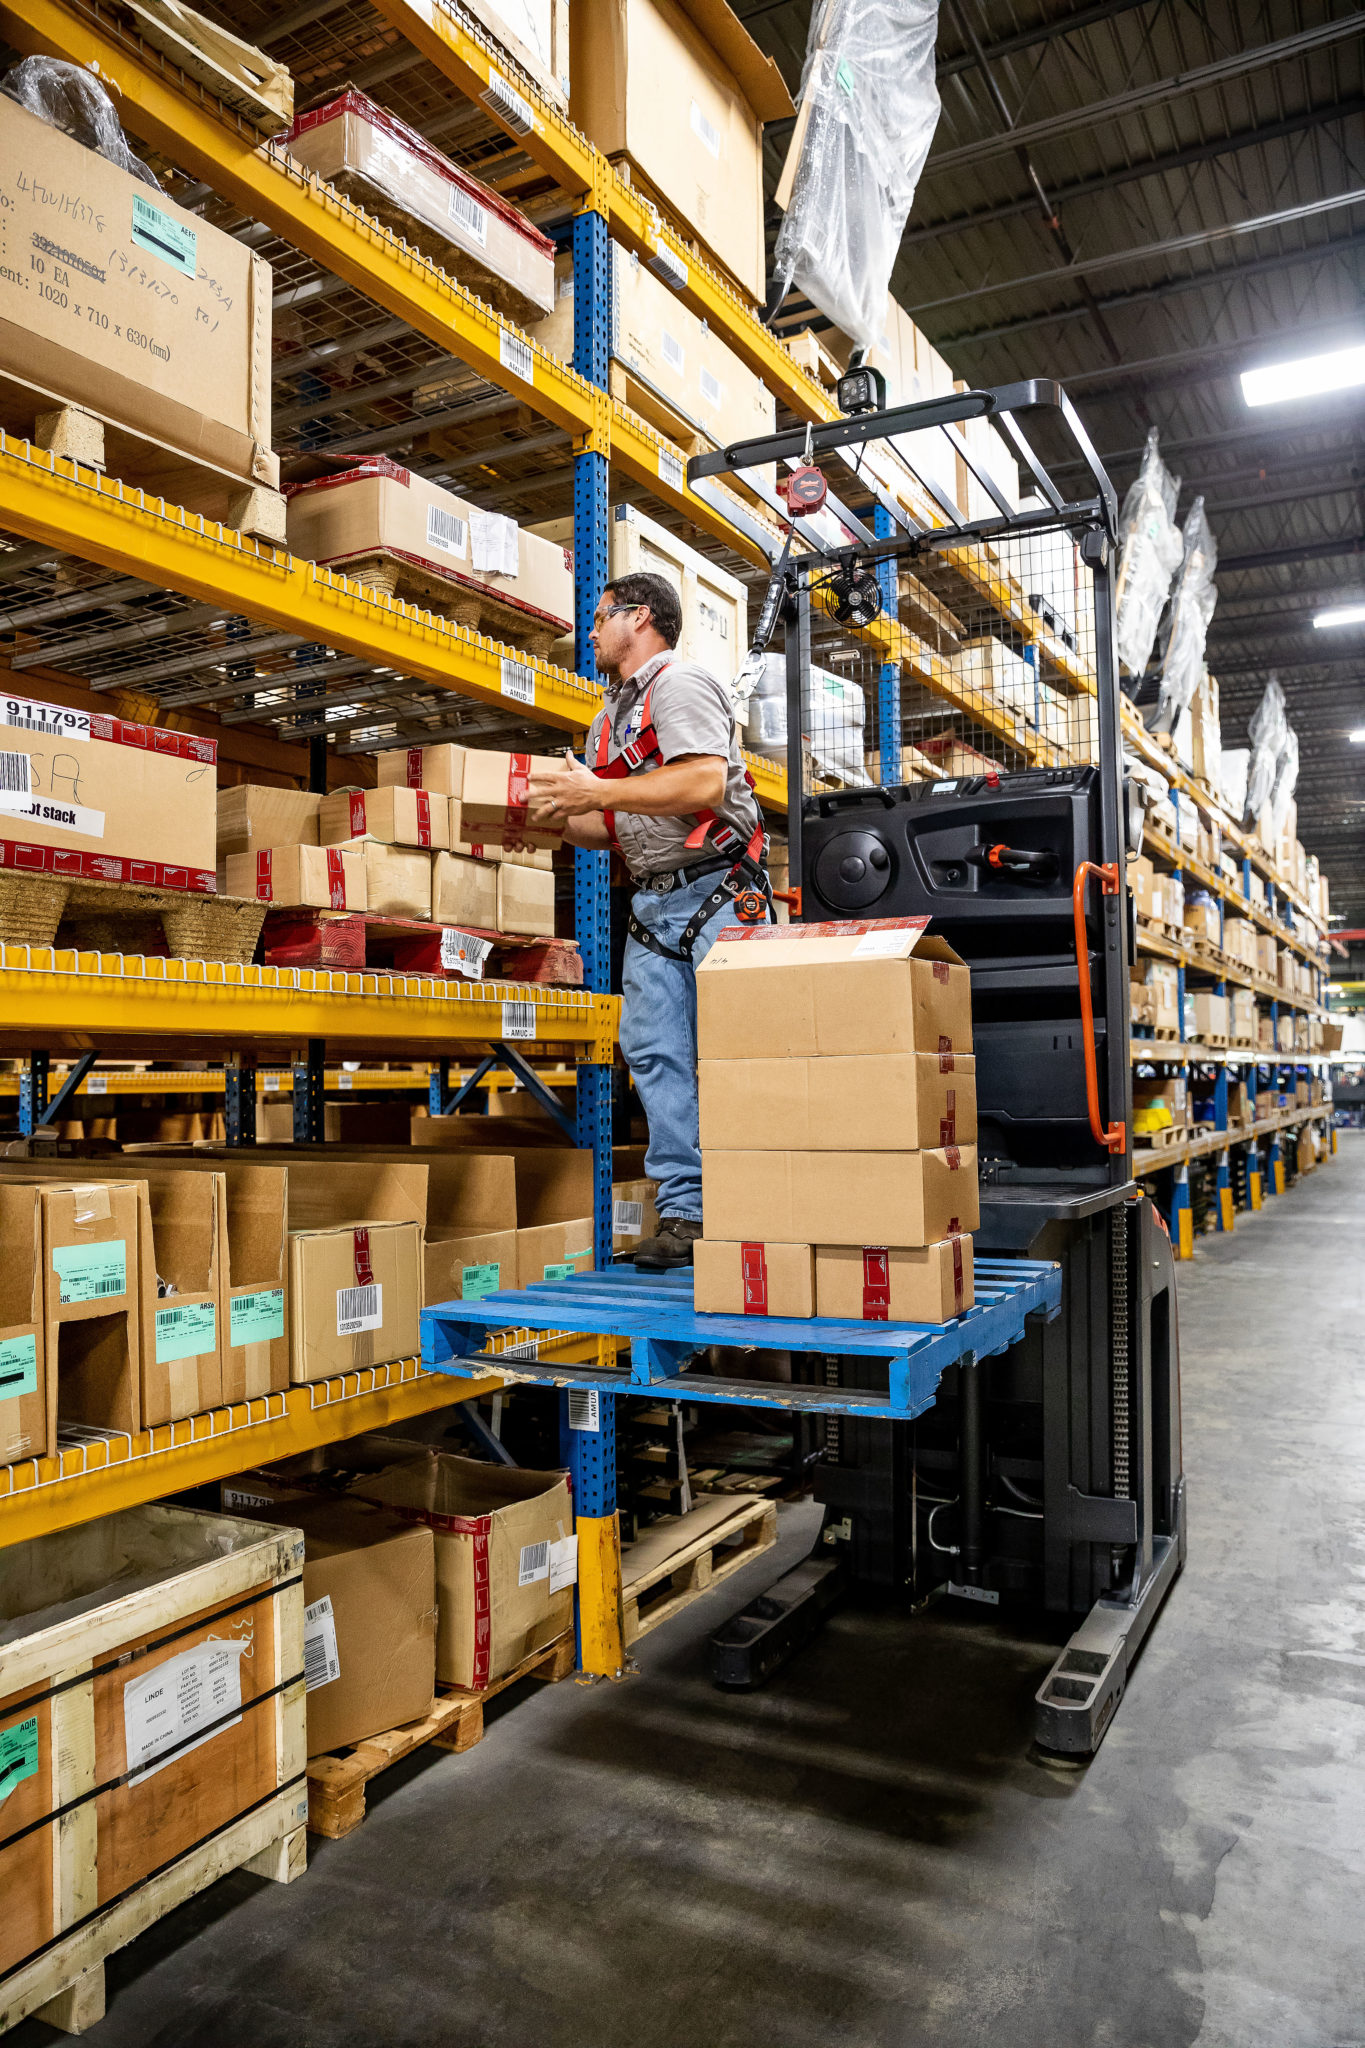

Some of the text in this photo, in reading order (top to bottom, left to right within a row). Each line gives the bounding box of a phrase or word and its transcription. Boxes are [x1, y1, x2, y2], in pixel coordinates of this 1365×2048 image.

[30, 254, 70, 288] 10 EA
[38, 281, 68, 309] 1020
[73, 304, 82, 317] x
[87, 306, 109, 331] 710
[114, 324, 122, 337] x
[6, 701, 90, 731] 911792
[43, 805, 76, 825] stack
[511, 1029, 528, 1038] AMUC
[144, 1687, 165, 1704] LINDE
